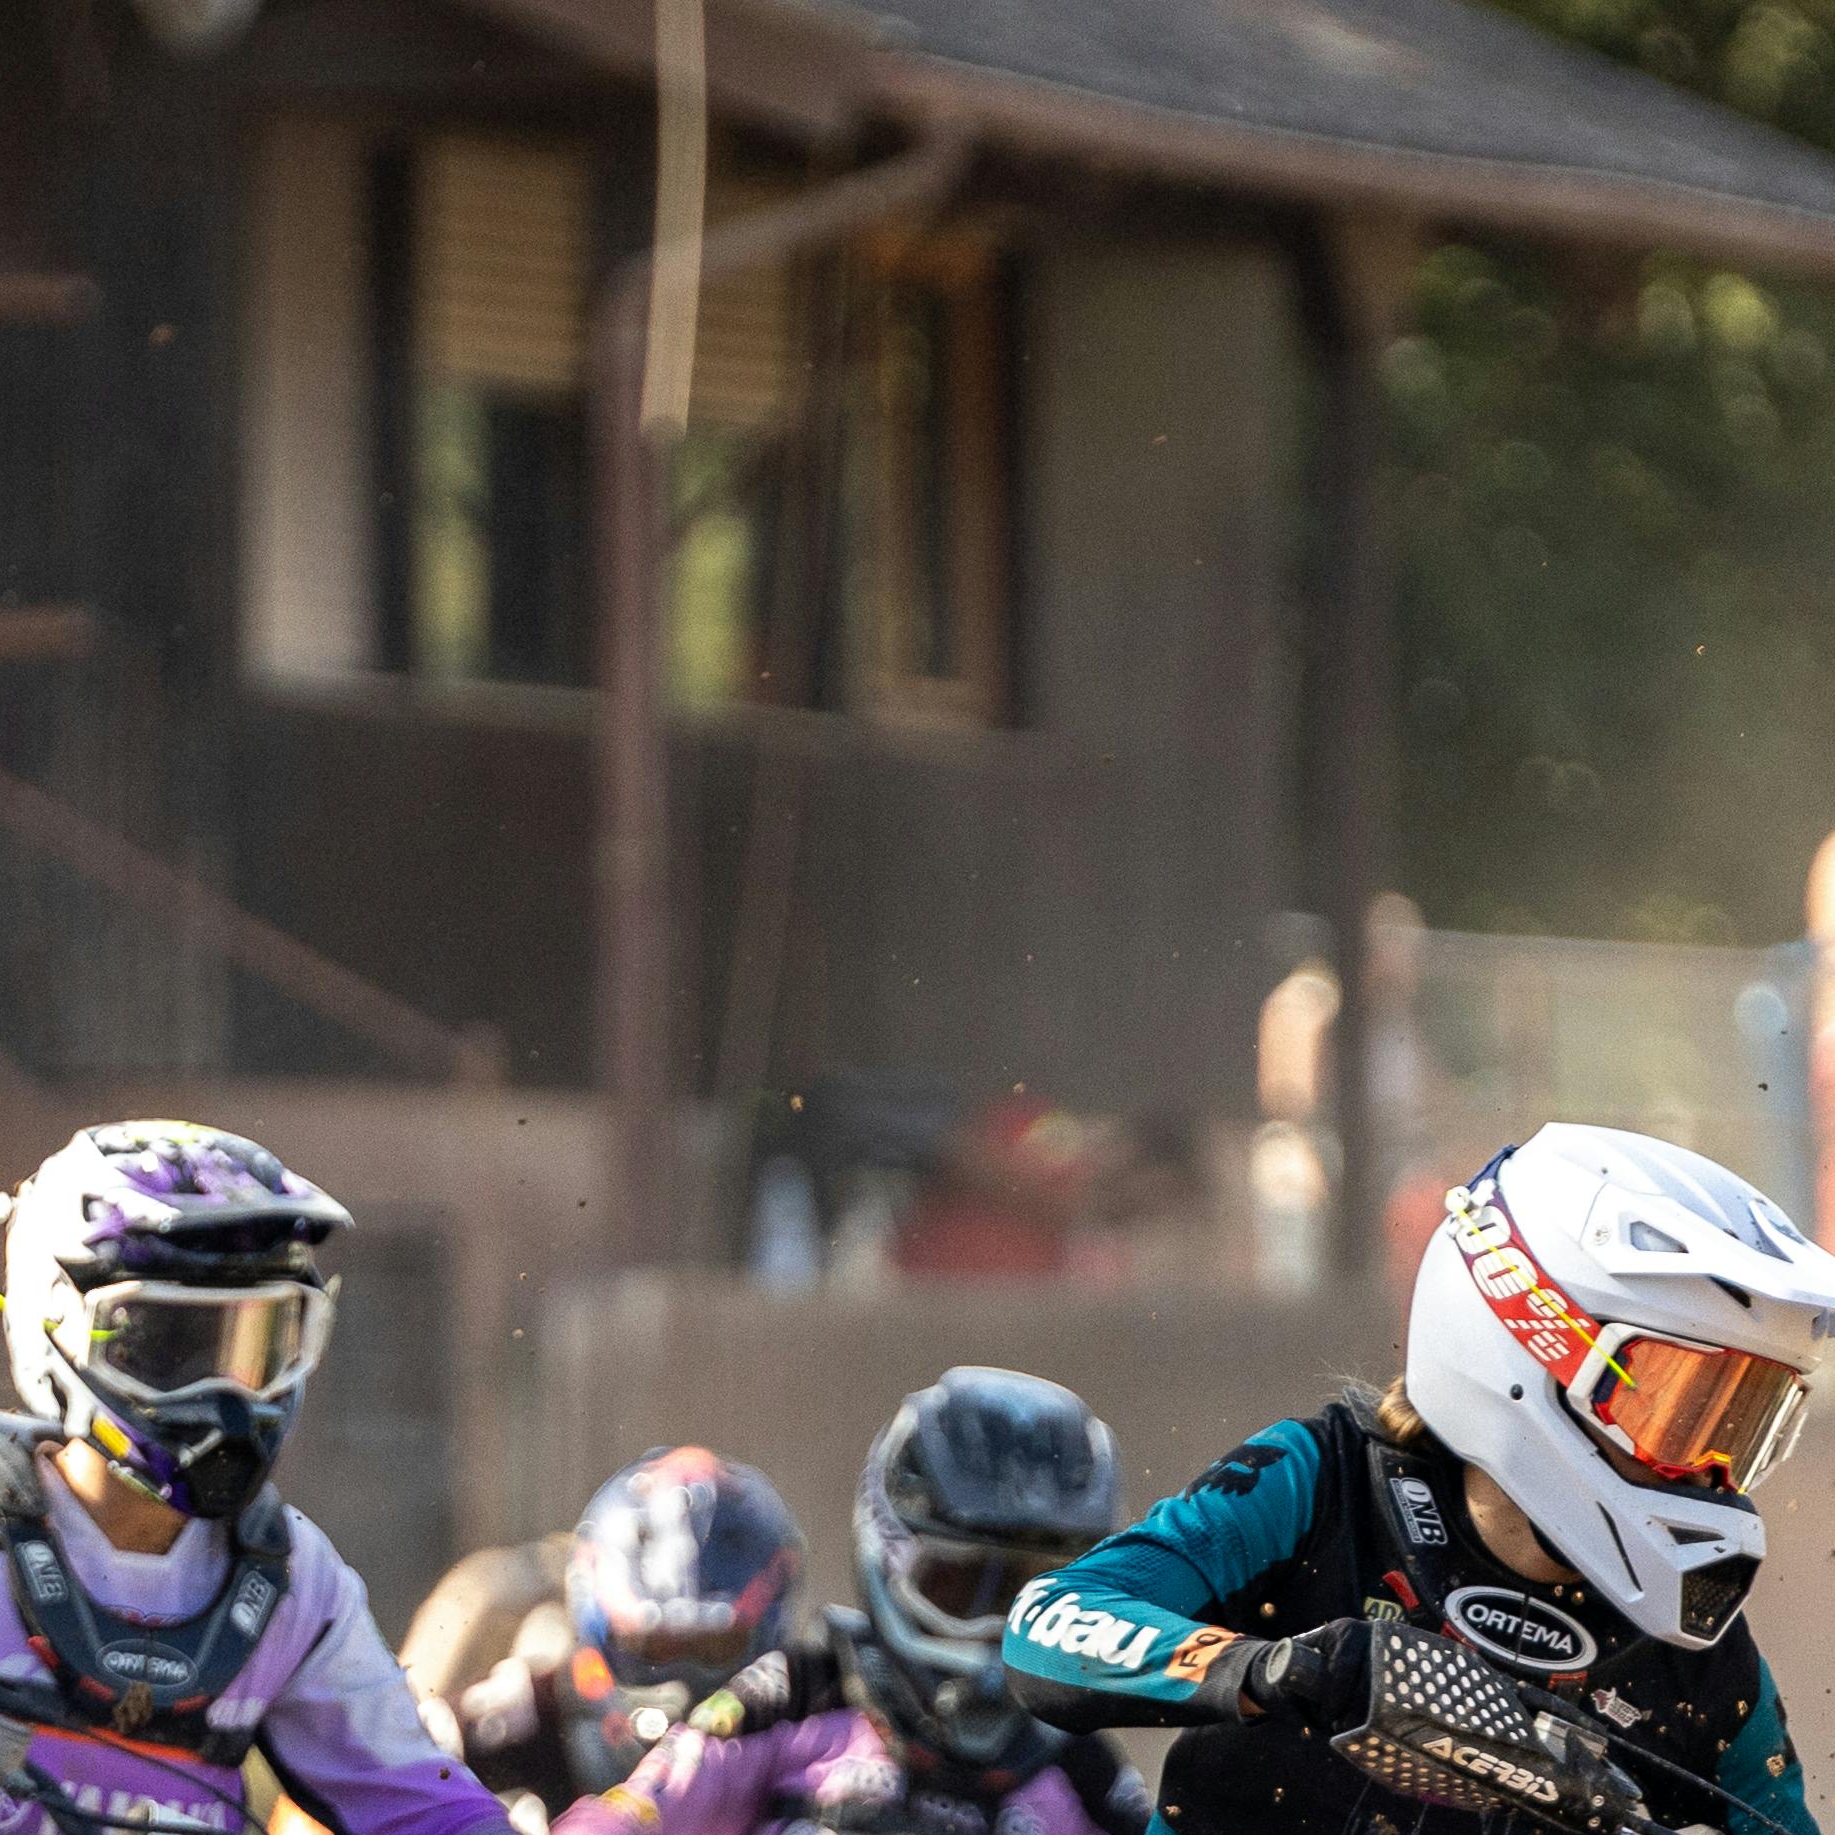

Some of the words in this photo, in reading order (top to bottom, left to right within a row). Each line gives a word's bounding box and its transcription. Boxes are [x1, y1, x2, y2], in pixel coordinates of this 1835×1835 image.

[1399, 1477, 1447, 1545] ONB
[1466, 1602, 1574, 1655] ORTEMA
[1422, 1736, 1560, 1802] ACERBIS
